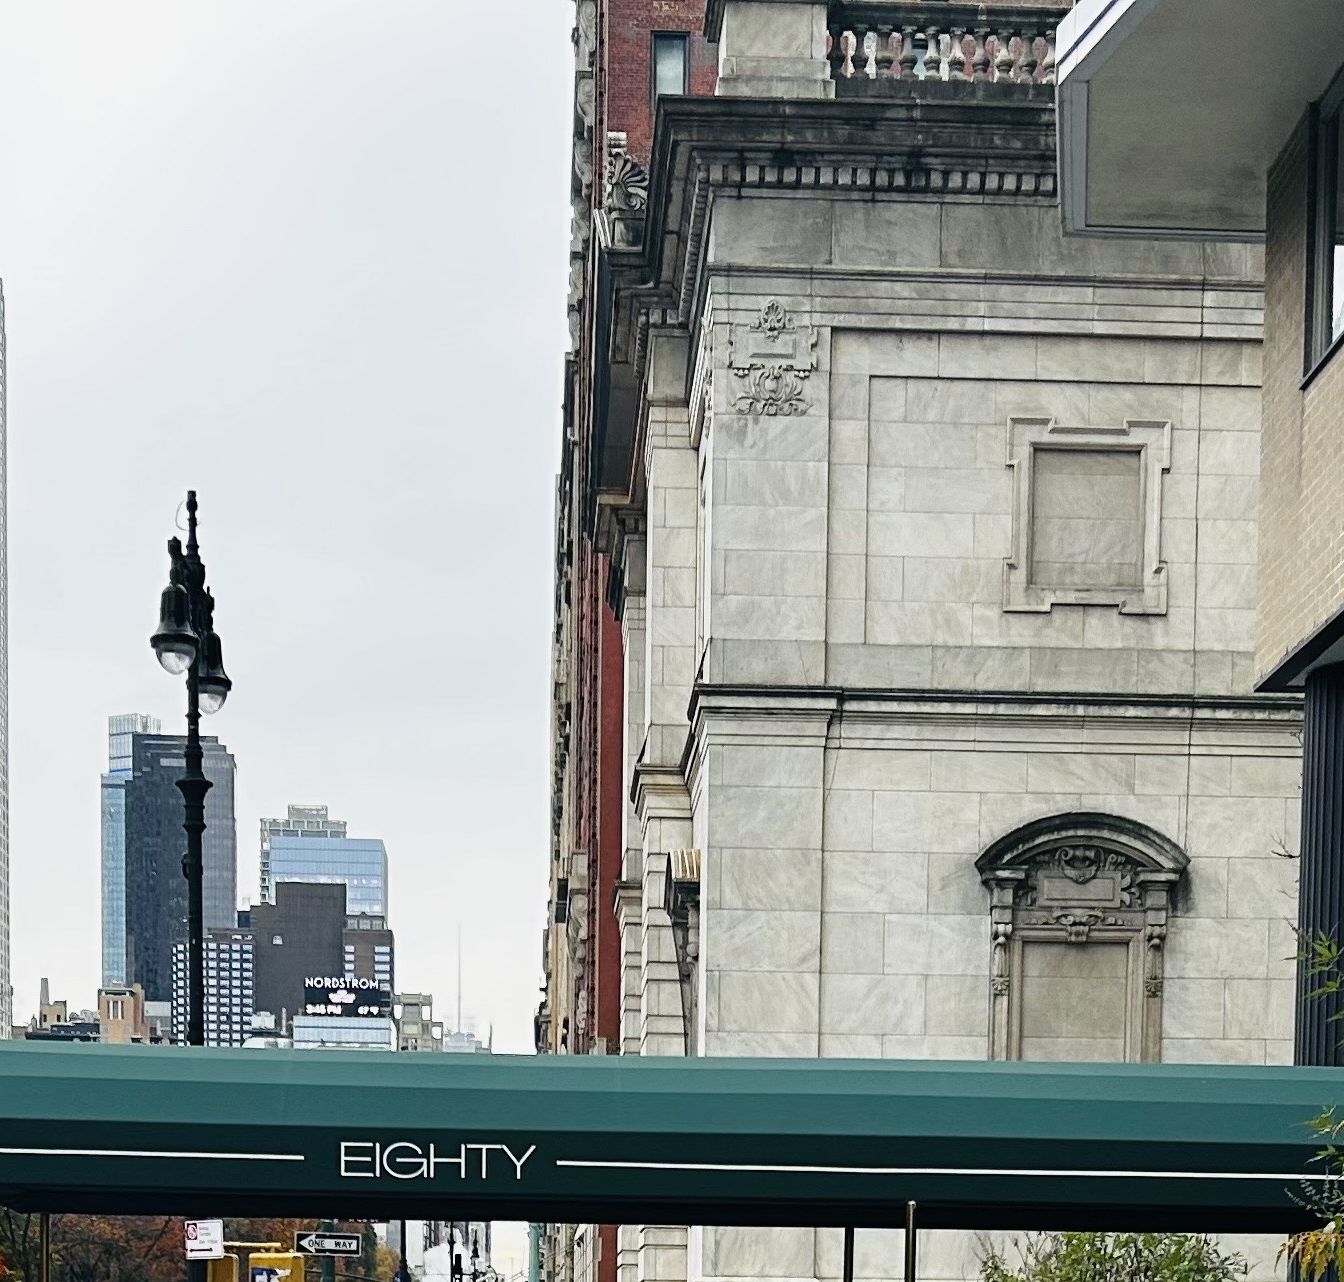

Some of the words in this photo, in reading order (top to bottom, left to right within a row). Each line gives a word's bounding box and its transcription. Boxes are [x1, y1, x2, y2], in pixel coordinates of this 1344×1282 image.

[305, 978, 379, 989] NORDSTROM
[340, 1141, 537, 1179] EIGHTY
[307, 1239, 326, 1249] ONE
[334, 1241, 354, 1249] WAY
